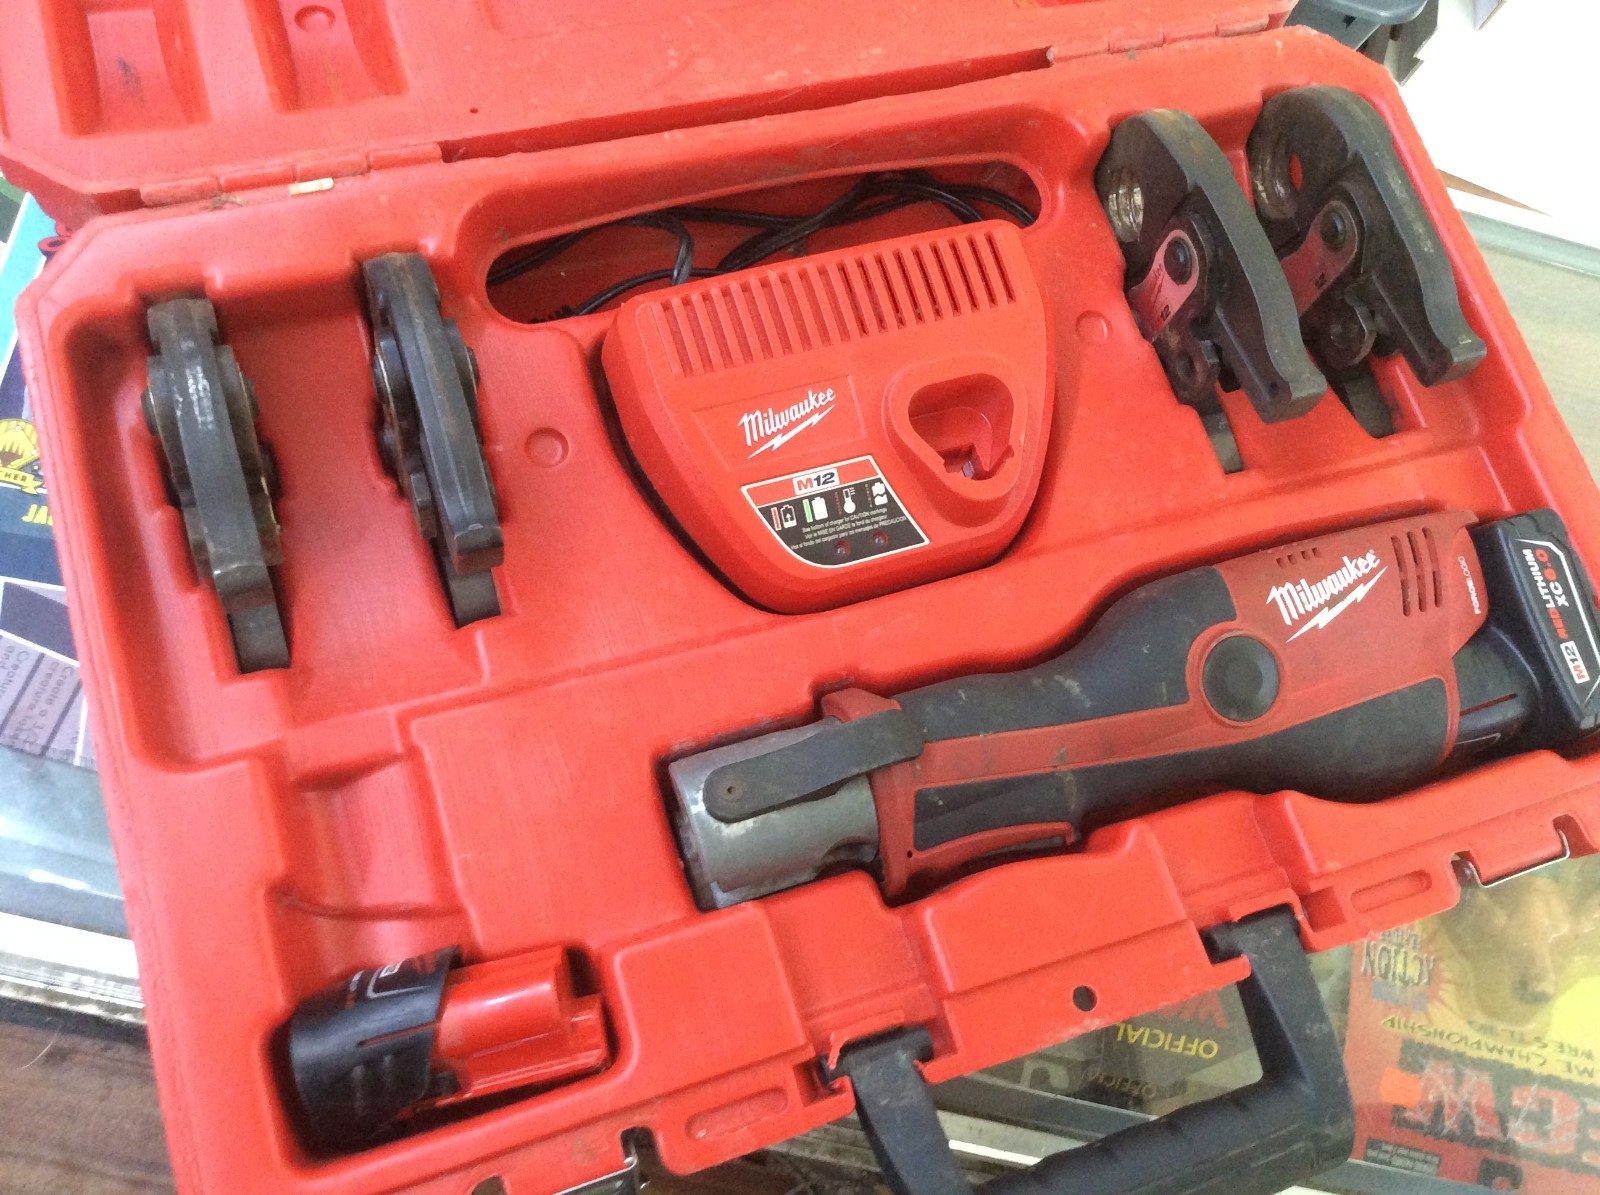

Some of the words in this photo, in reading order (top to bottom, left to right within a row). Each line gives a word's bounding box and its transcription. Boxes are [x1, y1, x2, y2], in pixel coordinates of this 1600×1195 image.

[737, 388, 836, 447] Milwaukee
[797, 472, 835, 491] M12
[850, 512, 870, 520] CAUTION
[1266, 552, 1381, 626] Milwaukee
[1564, 643, 1585, 680] M12
[1115, 1023, 1218, 1058] OFFICIAL
[1382, 1016, 1547, 1067] CHAMPIONSHIP
